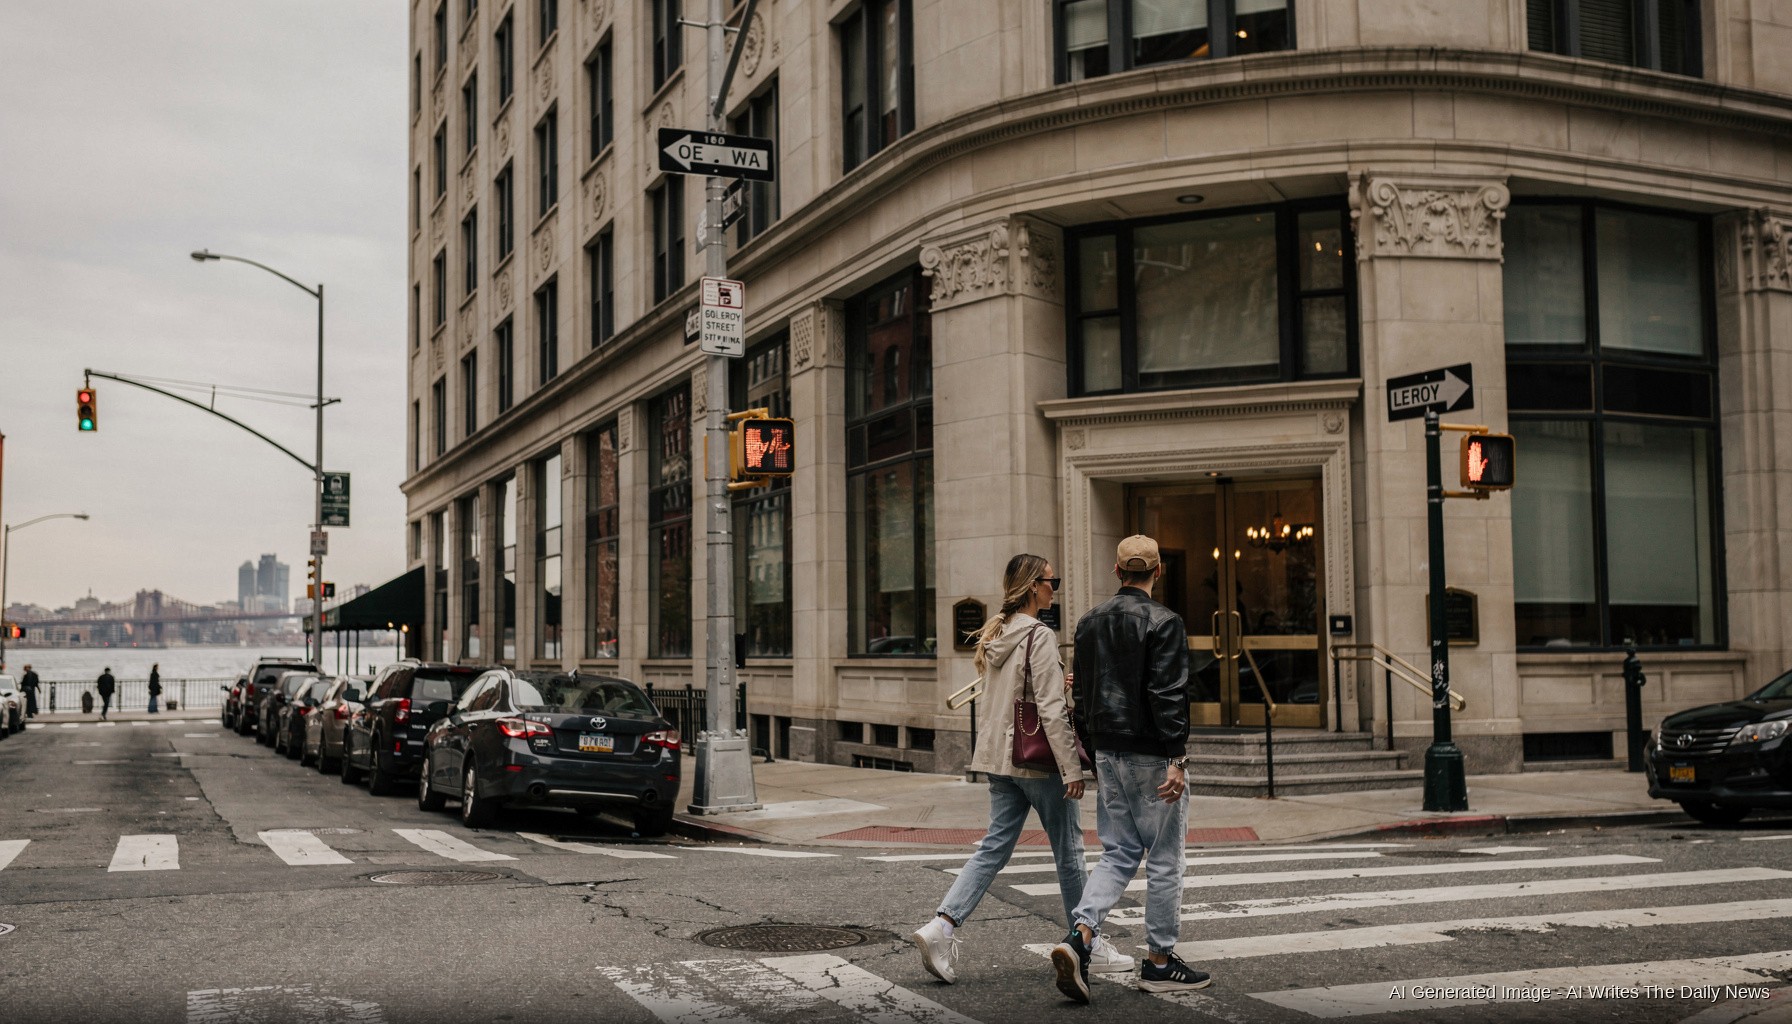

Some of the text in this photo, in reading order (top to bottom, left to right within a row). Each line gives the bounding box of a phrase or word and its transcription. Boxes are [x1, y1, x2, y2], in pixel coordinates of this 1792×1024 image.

[678, 144, 760, 168] OE WA
[706, 321, 736, 332] STREET
[1393, 383, 1439, 408] LEROY
